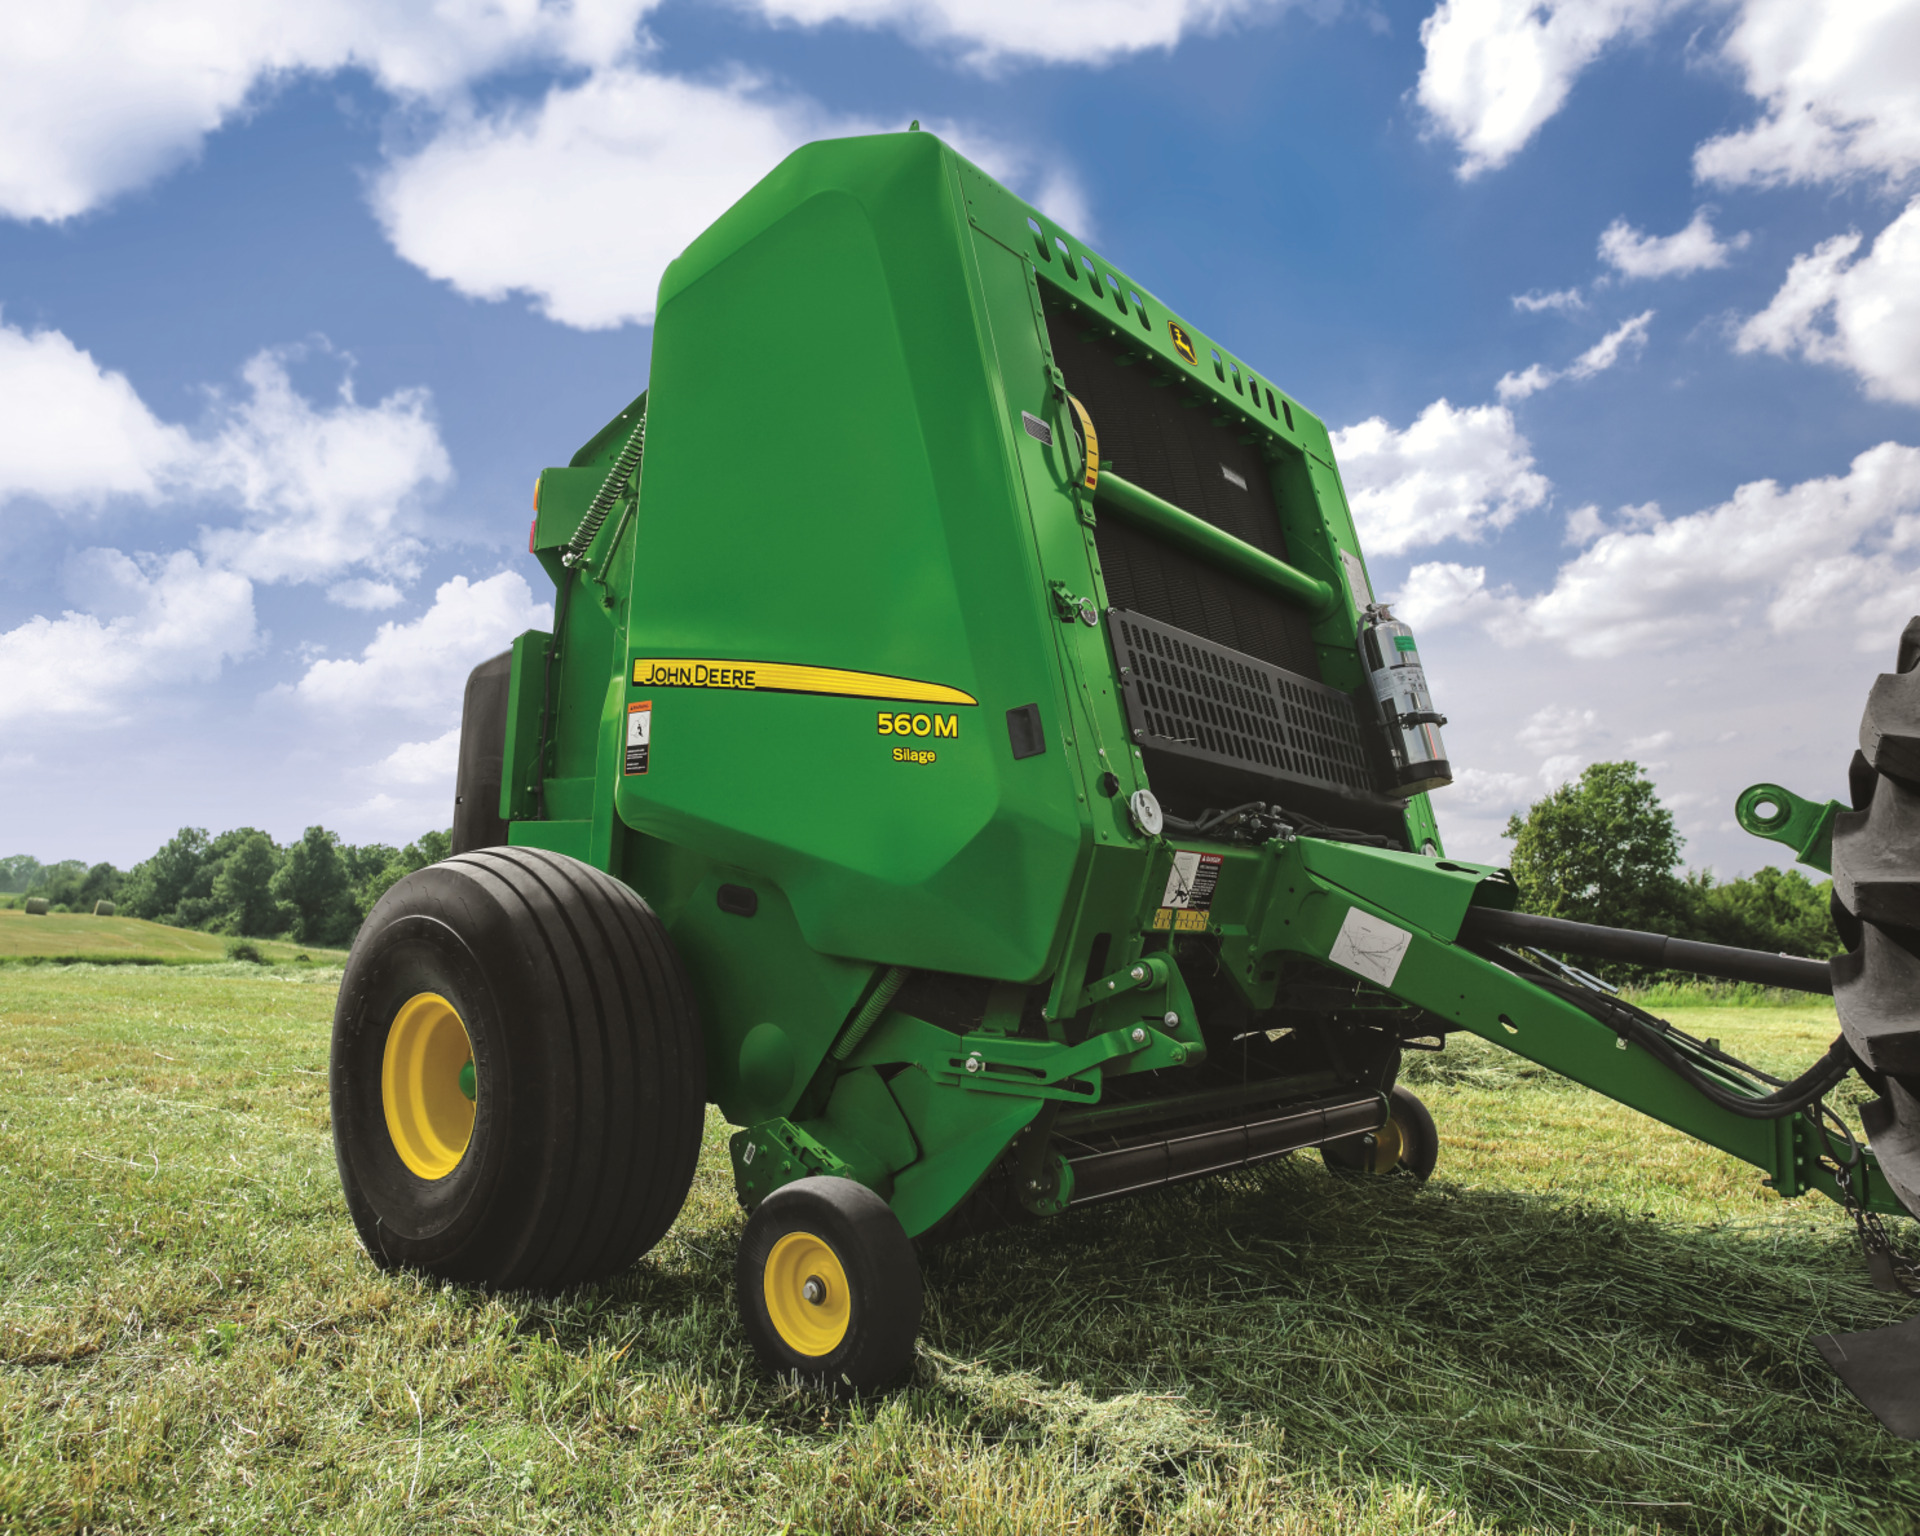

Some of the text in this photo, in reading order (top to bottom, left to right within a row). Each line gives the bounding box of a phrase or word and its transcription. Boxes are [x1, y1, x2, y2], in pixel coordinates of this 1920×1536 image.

[645, 664, 756, 686] JOHN DEERE
[892, 747, 937, 766] Silage
